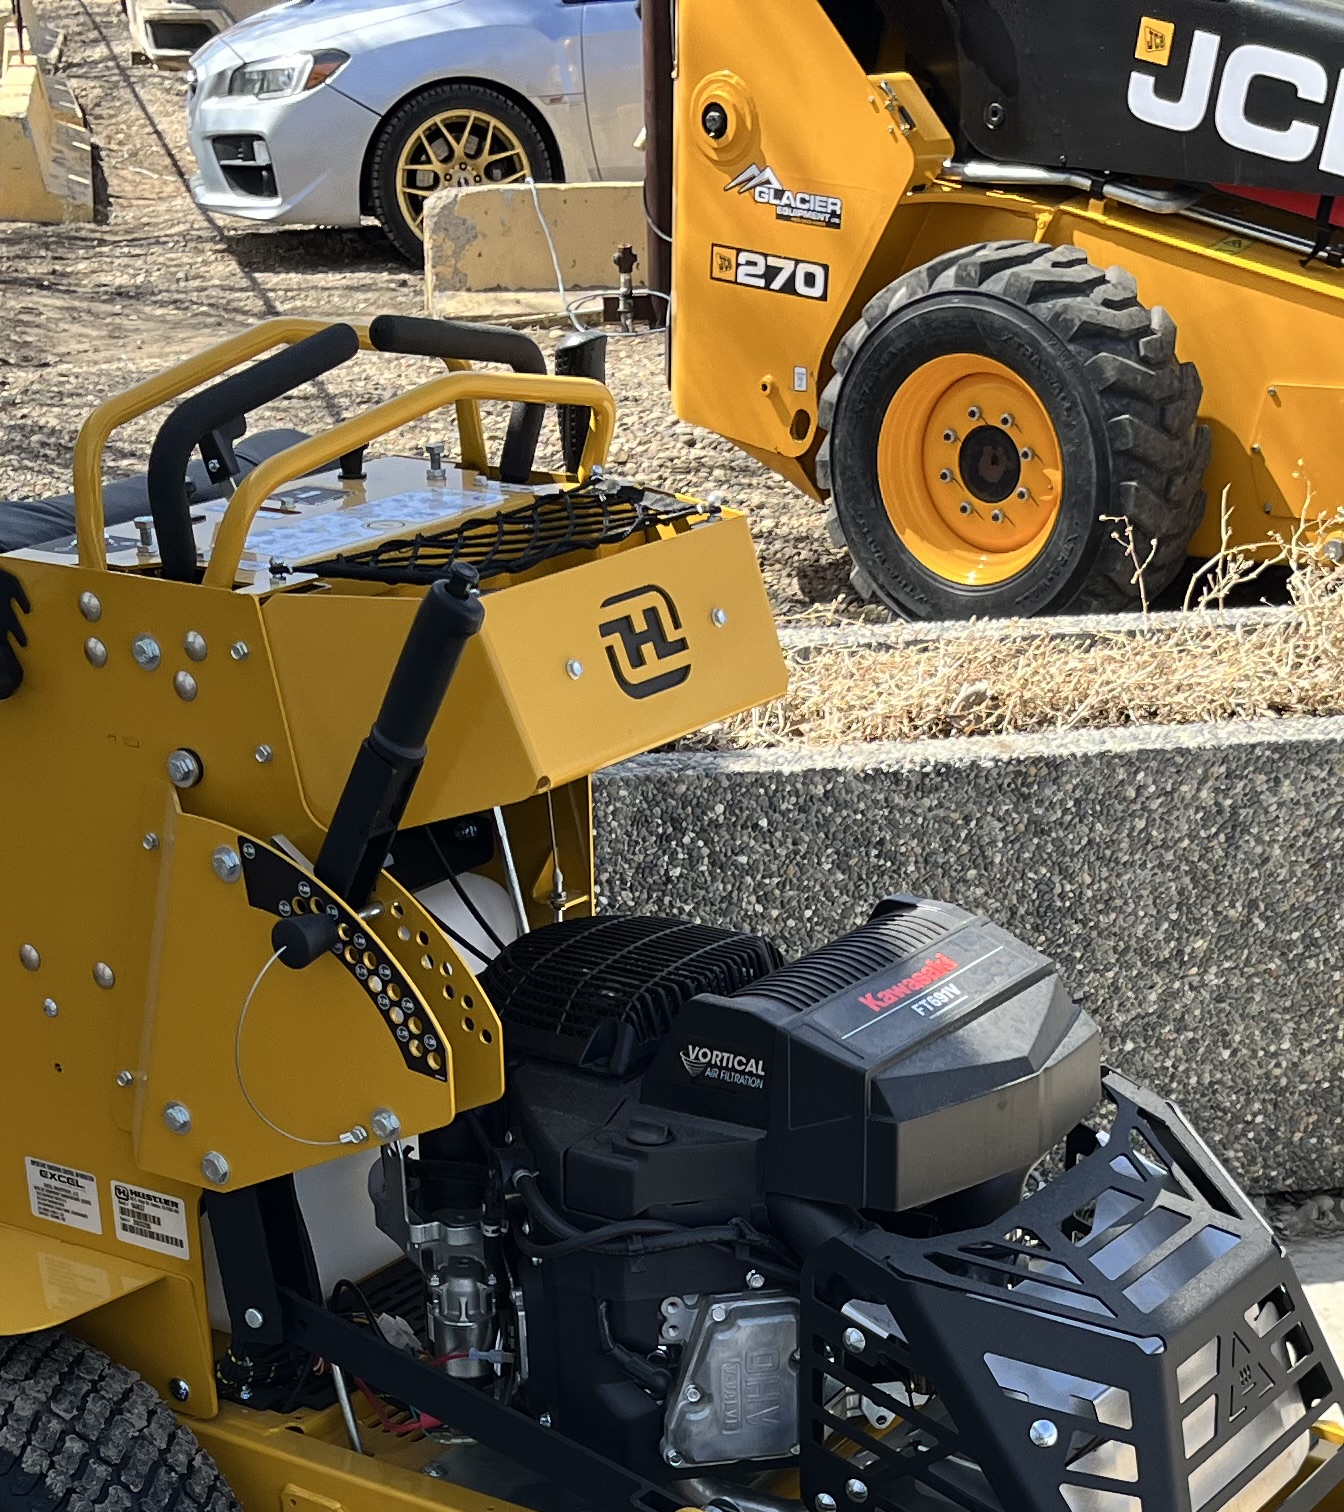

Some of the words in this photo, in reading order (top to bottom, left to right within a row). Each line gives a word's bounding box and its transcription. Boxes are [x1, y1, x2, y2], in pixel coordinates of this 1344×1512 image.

[754, 186, 843, 215] GLACIER
[736, 251, 825, 299] 270
[858, 952, 959, 1012] Kawasaki
[911, 983, 962, 1016] FT691V
[687, 1044, 765, 1076] VORTICAL
[704, 1067, 719, 1079] AIR
[719, 1070, 764, 1089] FILTRATION
[39, 1169, 85, 1189] EXCEL
[129, 1189, 179, 1209] HUSTLER
